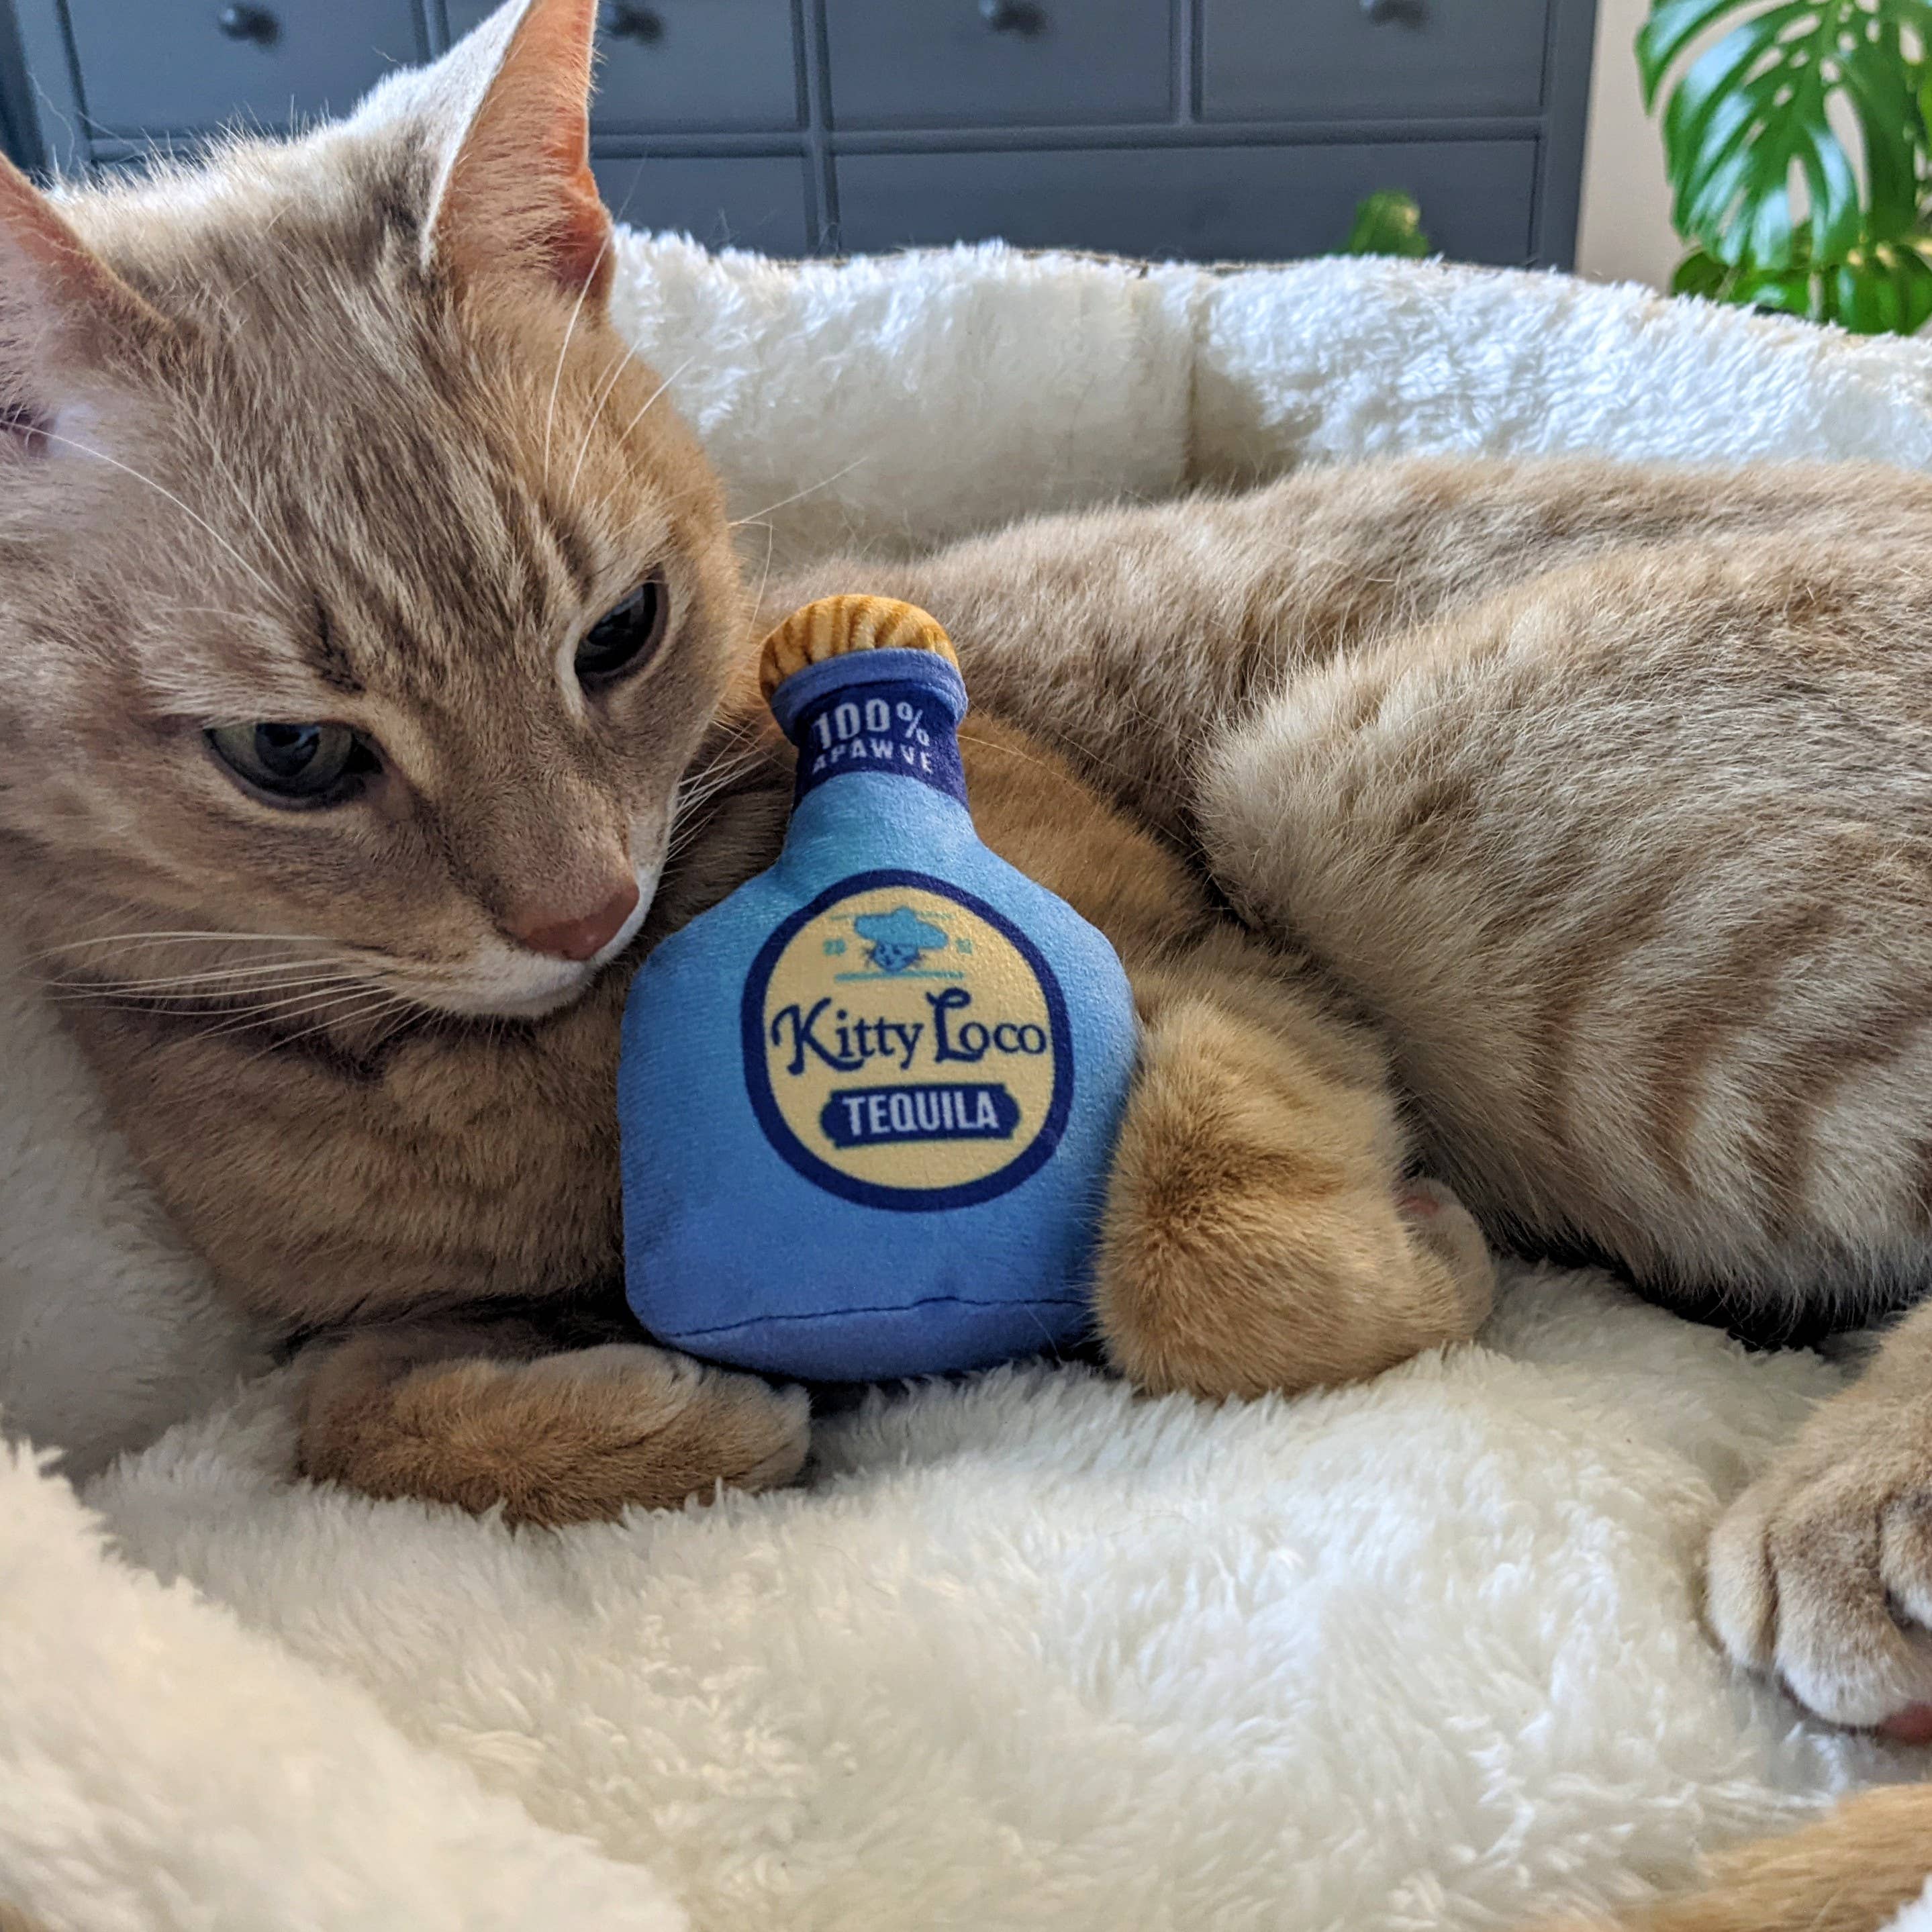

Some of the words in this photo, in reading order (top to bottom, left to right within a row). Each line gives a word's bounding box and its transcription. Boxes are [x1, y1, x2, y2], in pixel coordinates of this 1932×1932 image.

[813, 698, 930, 750] 100%
[771, 998, 924, 1075] Kitty
[926, 987, 1047, 1063] Loco
[842, 1091, 1000, 1136] TEQUILA
